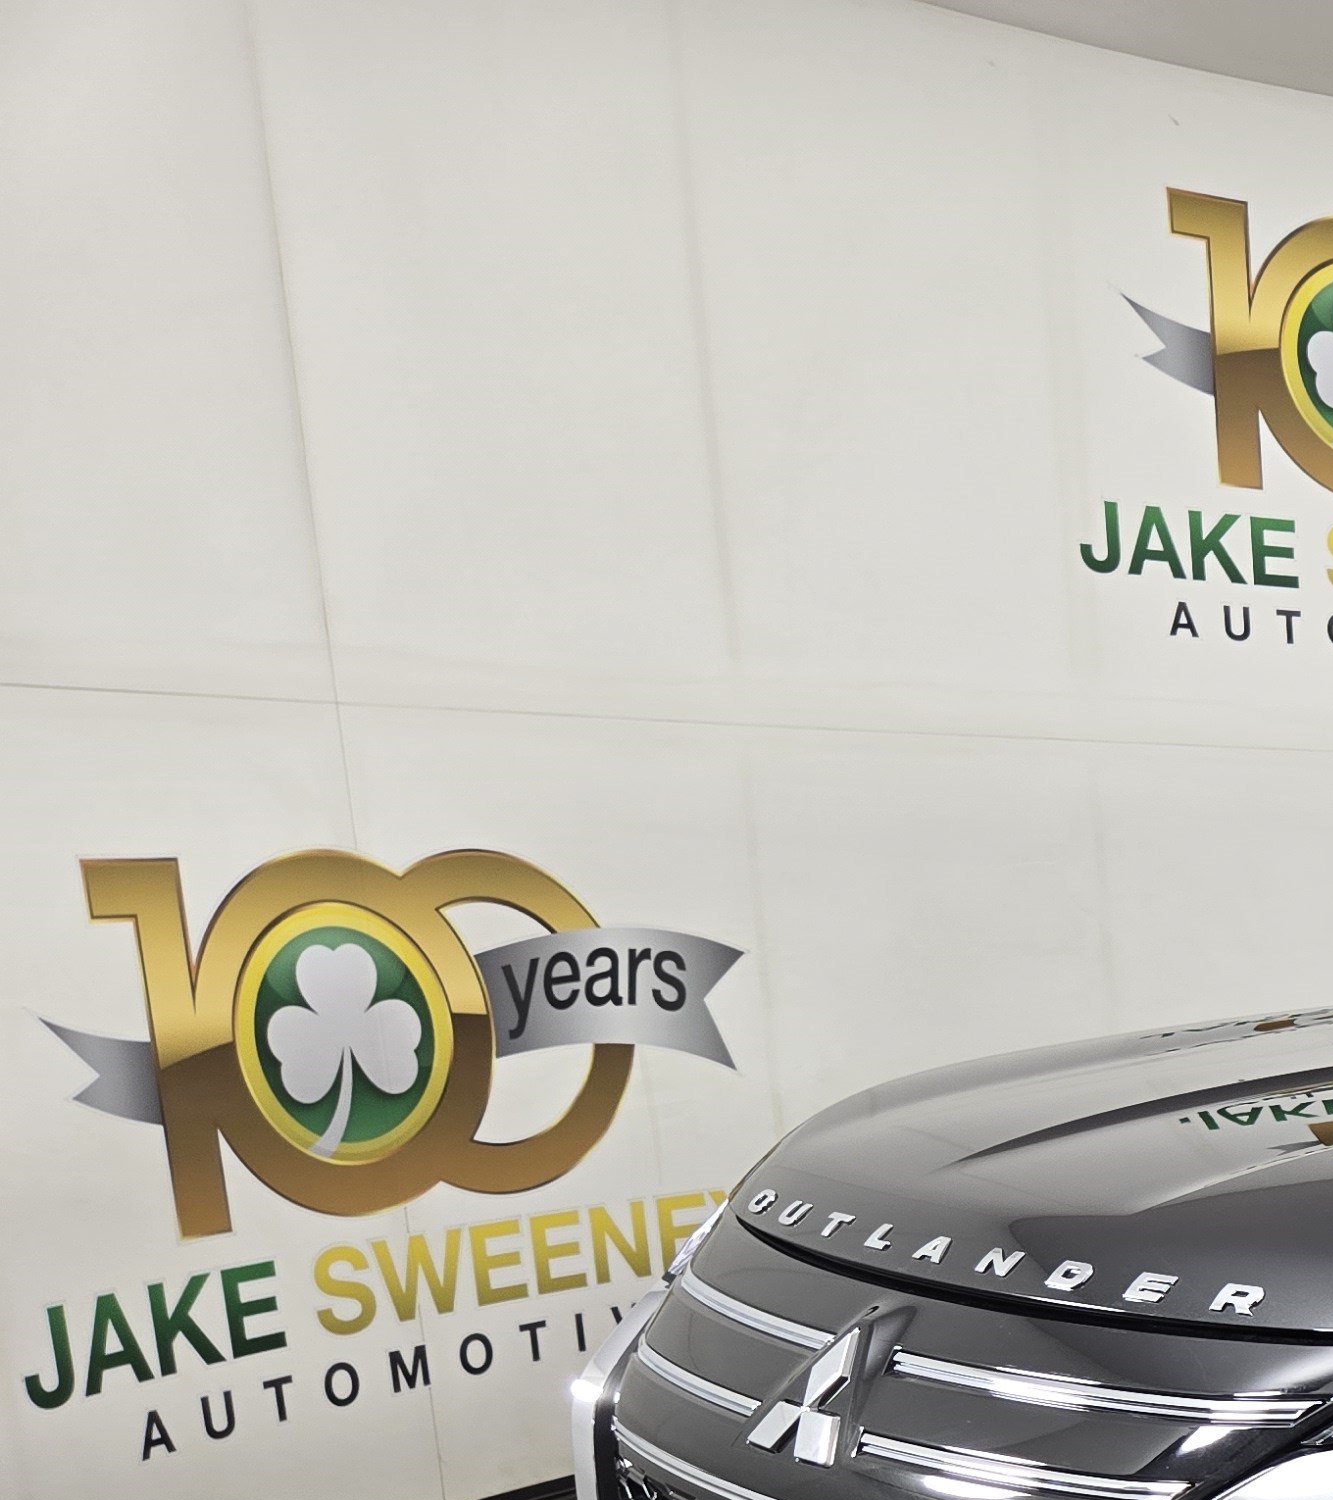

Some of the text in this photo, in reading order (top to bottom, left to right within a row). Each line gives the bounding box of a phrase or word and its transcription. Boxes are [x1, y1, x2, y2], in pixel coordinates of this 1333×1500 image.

[1080, 500, 1299, 588] JAKE
[501, 945, 689, 1039] years
[23, 1189, 728, 1409] JAKE SWEENE
[747, 1189, 1266, 1317] OUTLANDER
